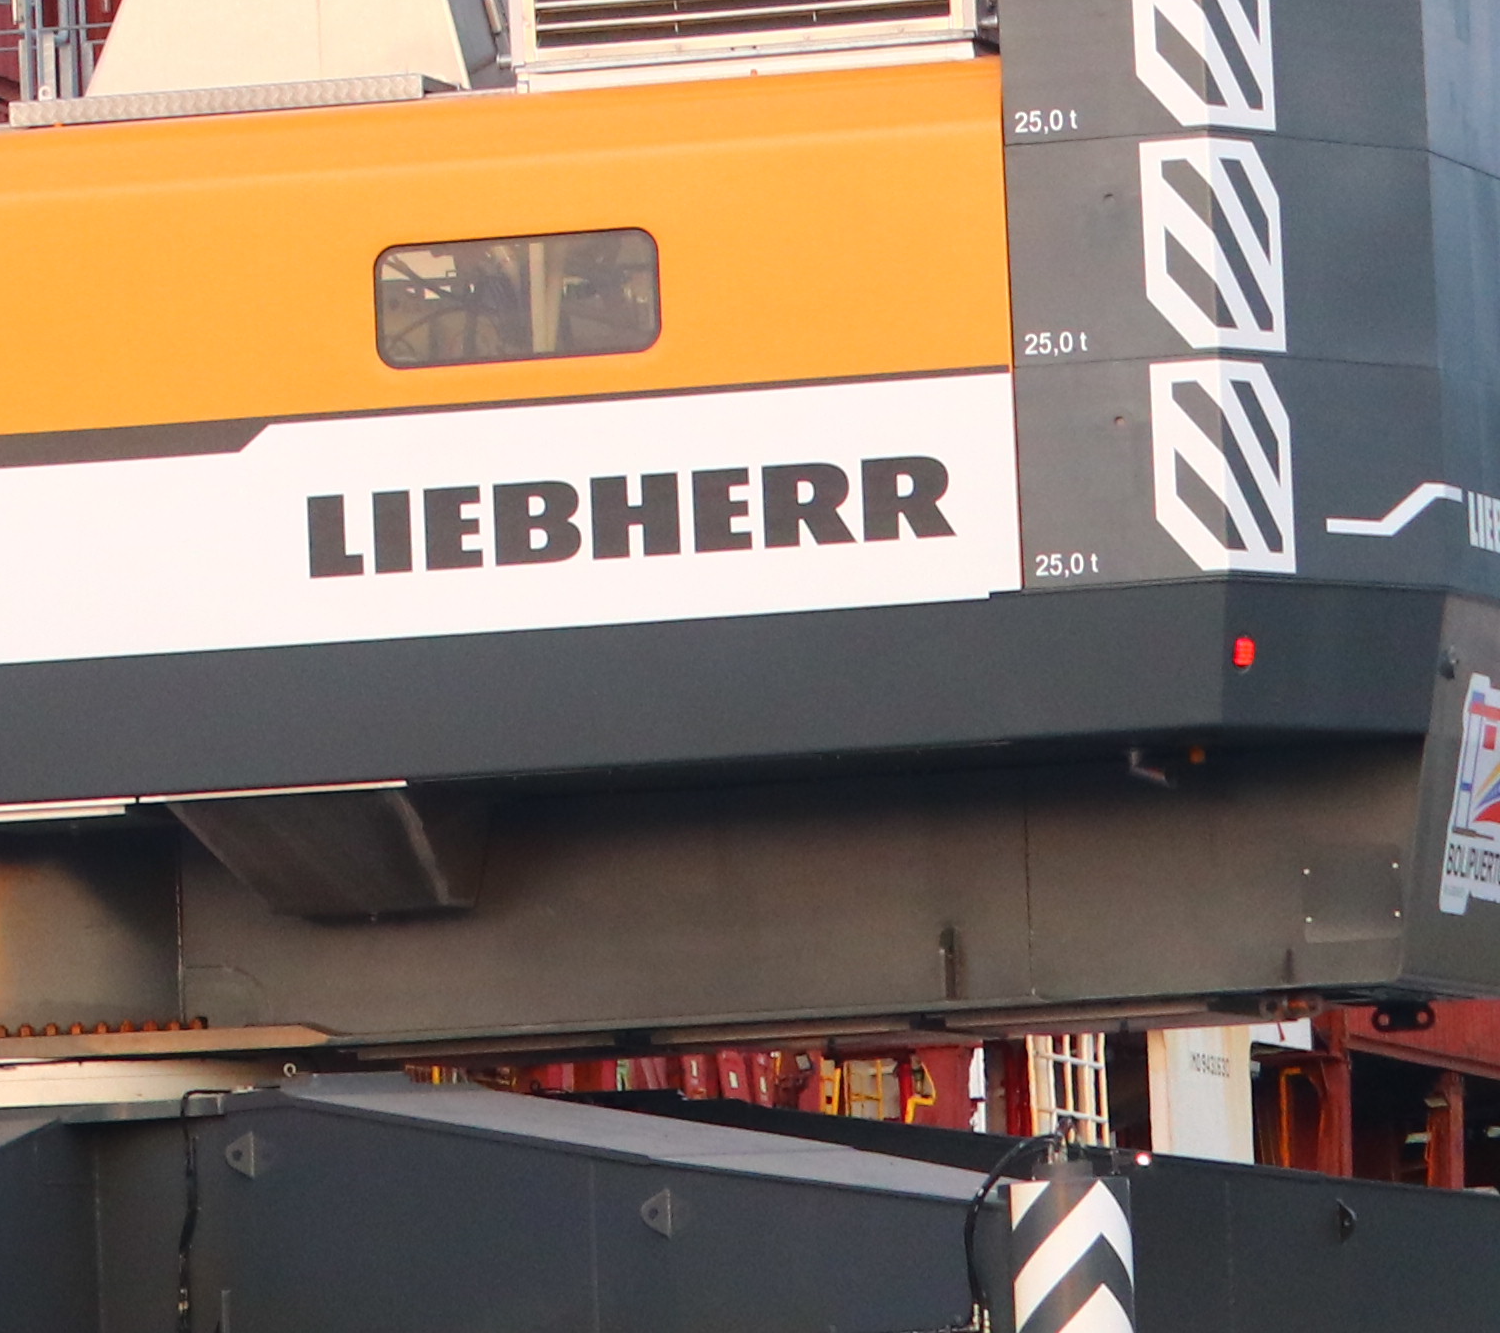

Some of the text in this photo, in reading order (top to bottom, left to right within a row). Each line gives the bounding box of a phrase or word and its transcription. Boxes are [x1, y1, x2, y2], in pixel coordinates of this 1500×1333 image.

[1014, 110, 1078, 134] 25,0 t
[1024, 332, 1088, 356] 25,0 t
[306, 455, 957, 579] LIEBHERR
[1035, 553, 1099, 578] 25,0 t
